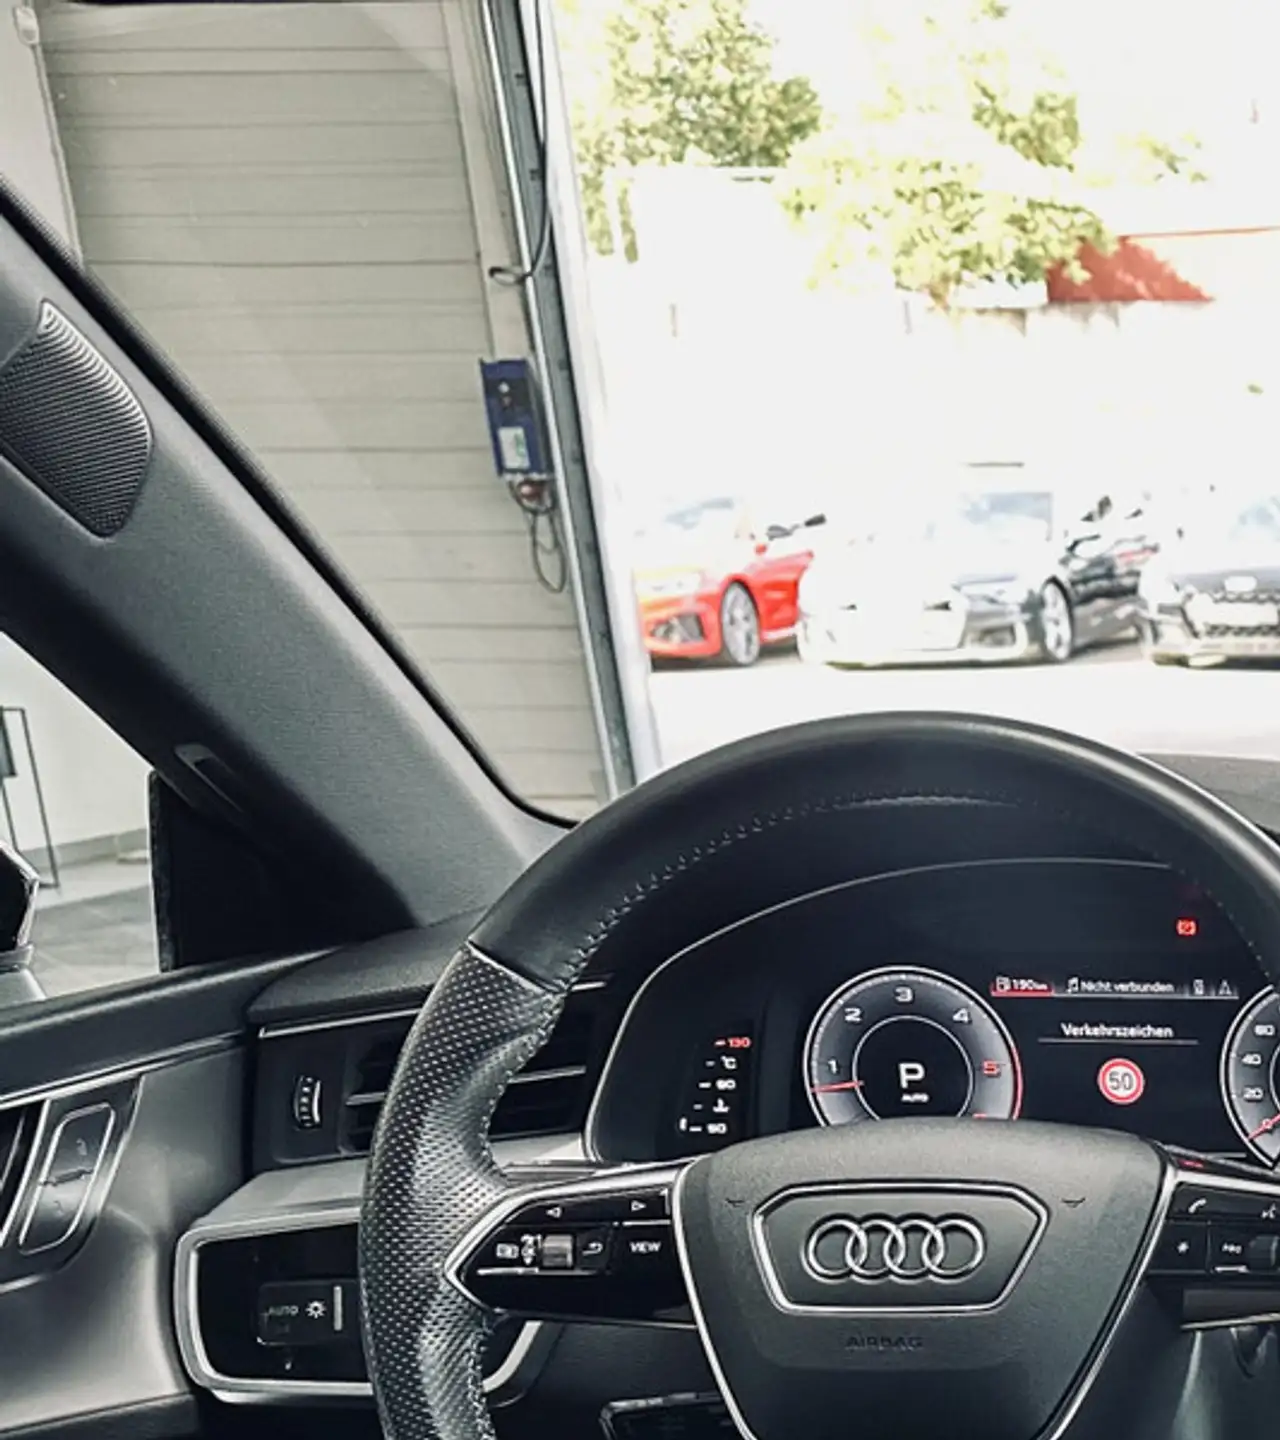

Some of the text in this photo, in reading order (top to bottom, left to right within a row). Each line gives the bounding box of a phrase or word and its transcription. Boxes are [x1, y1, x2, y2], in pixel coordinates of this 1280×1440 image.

[1080, 979, 1174, 993] Nicht verbunden
[895, 986, 913, 1002] 3
[844, 1007, 862, 1022] 2
[953, 1007, 970, 1022] 4
[1060, 1023, 1174, 1039] Verkehrszeichen
[1242, 1053, 1262, 1065] 40
[827, 1059, 838, 1075] 1
[983, 1060, 1000, 1075] 5
[899, 1062, 925, 1089] P
[1109, 1071, 1134, 1091] 50
[1243, 1087, 1263, 1101] 20
[629, 1241, 662, 1254] VIEW
[268, 1305, 299, 1317] AUTO
[846, 1335, 924, 1350] AIRBAG
